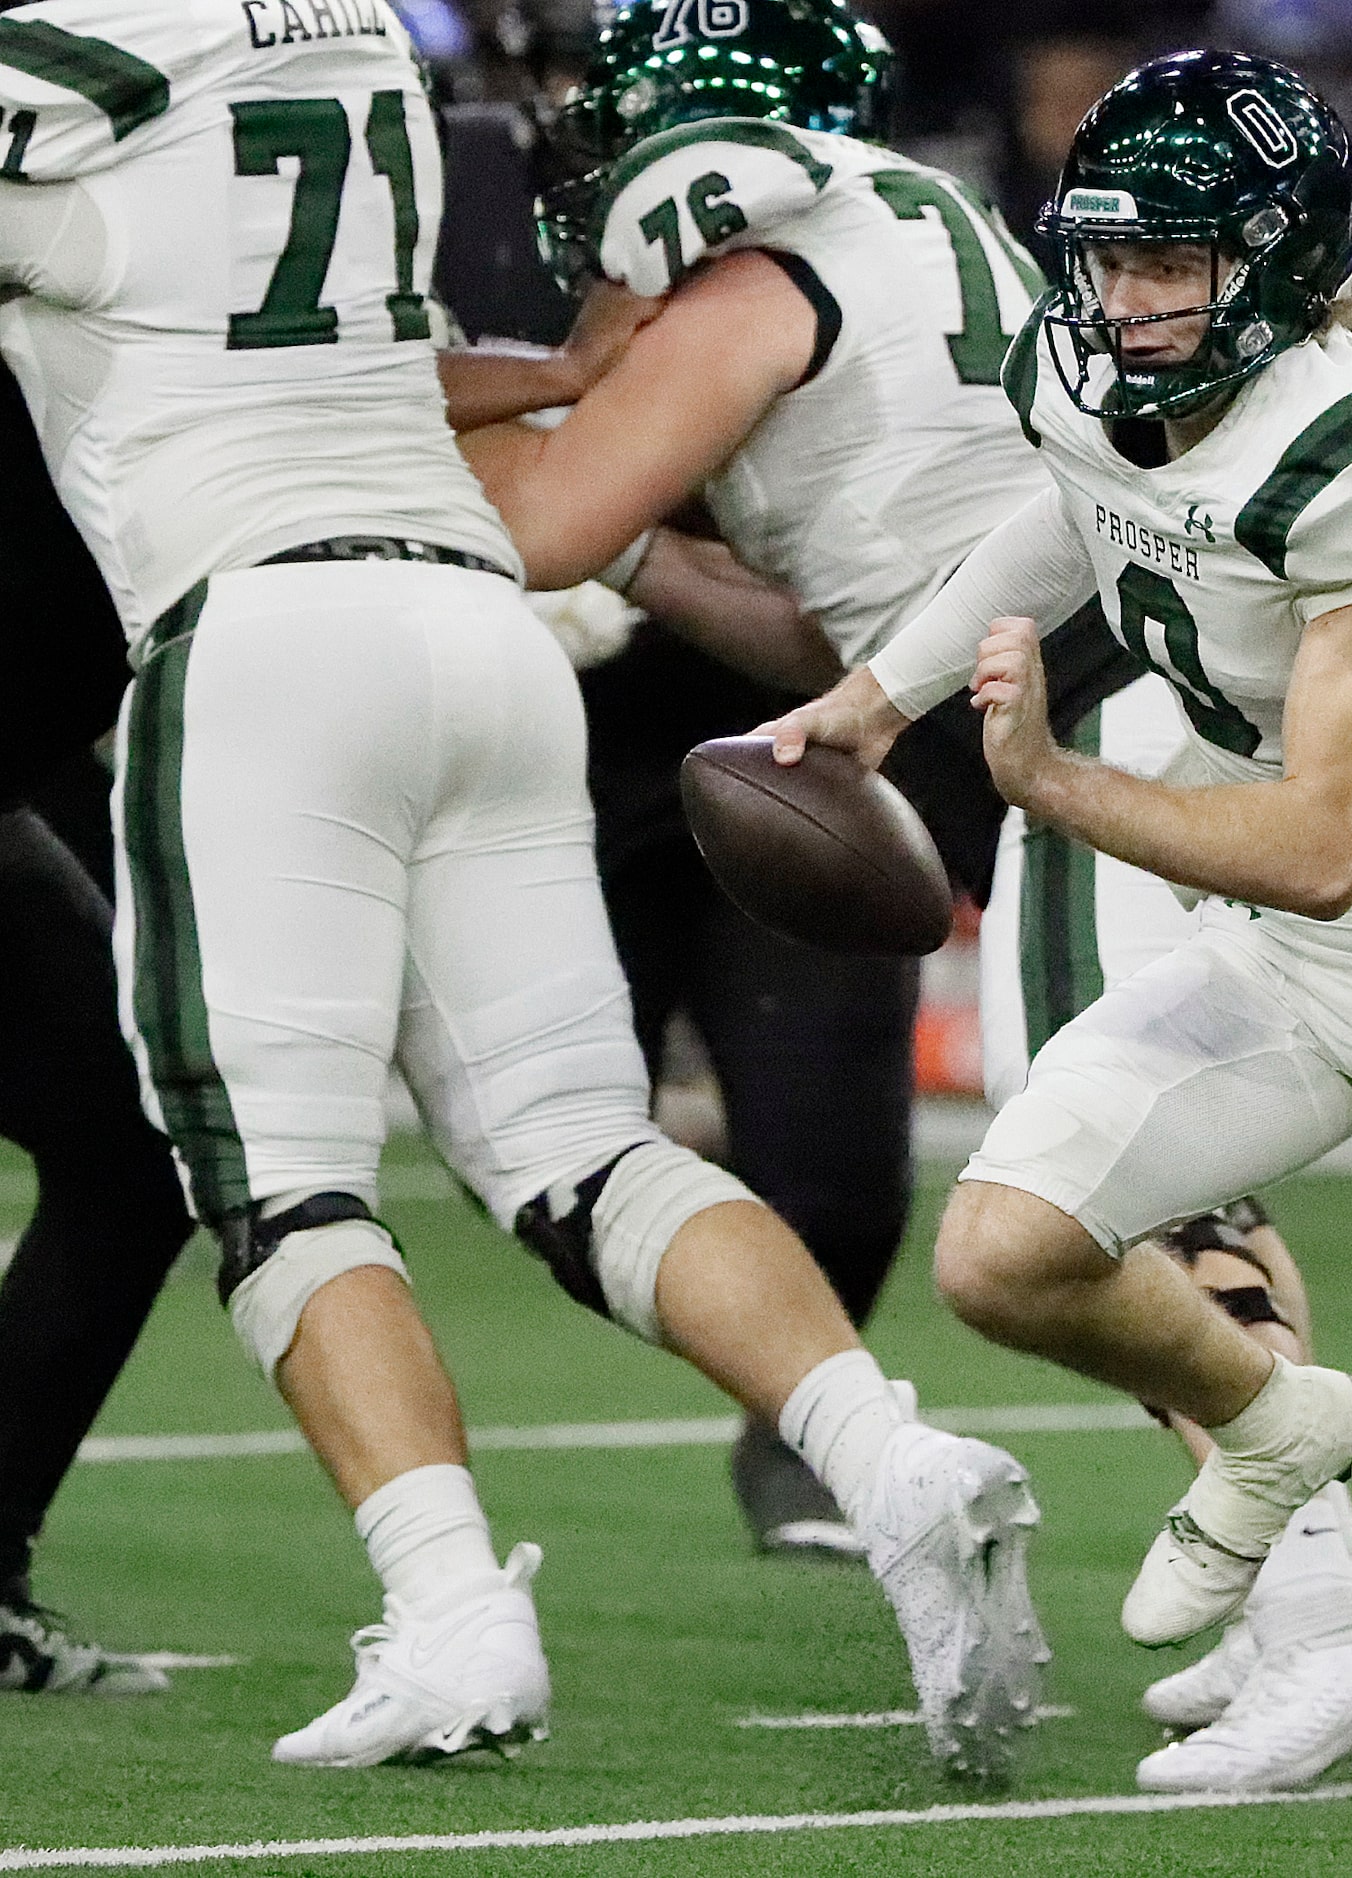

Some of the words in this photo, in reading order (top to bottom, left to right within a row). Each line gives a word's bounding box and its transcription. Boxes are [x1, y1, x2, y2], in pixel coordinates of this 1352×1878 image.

[0, 105, 37, 180] 1
[226, 89, 431, 350] 71
[638, 171, 748, 284] 76
[1070, 194, 1120, 212] PROSPER
[1096, 504, 1199, 580] PROSPER
[1116, 561, 1262, 758] 0
